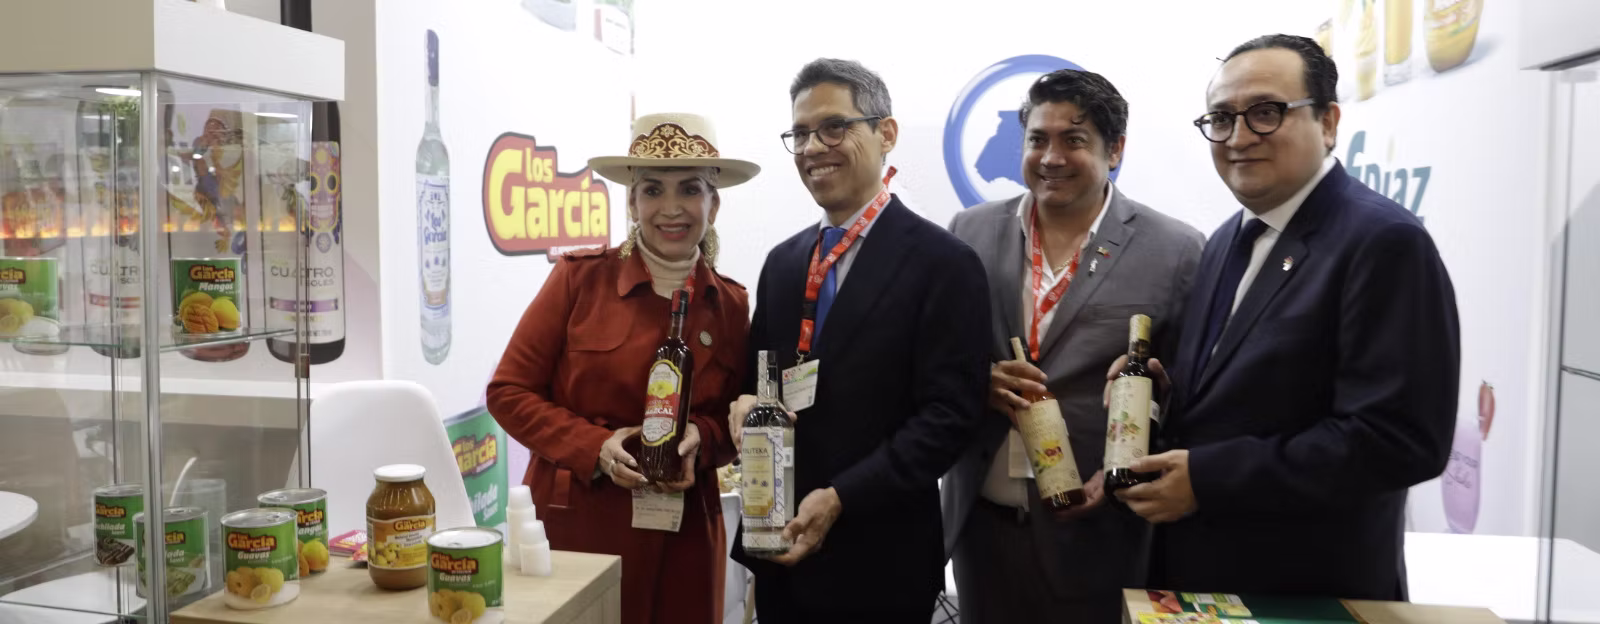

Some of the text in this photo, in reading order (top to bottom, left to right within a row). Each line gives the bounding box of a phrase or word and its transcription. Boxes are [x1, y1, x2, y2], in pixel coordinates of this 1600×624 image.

[525, 148, 553, 183] los
[489, 149, 608, 240] García
[199, 282, 233, 292] Mangos
